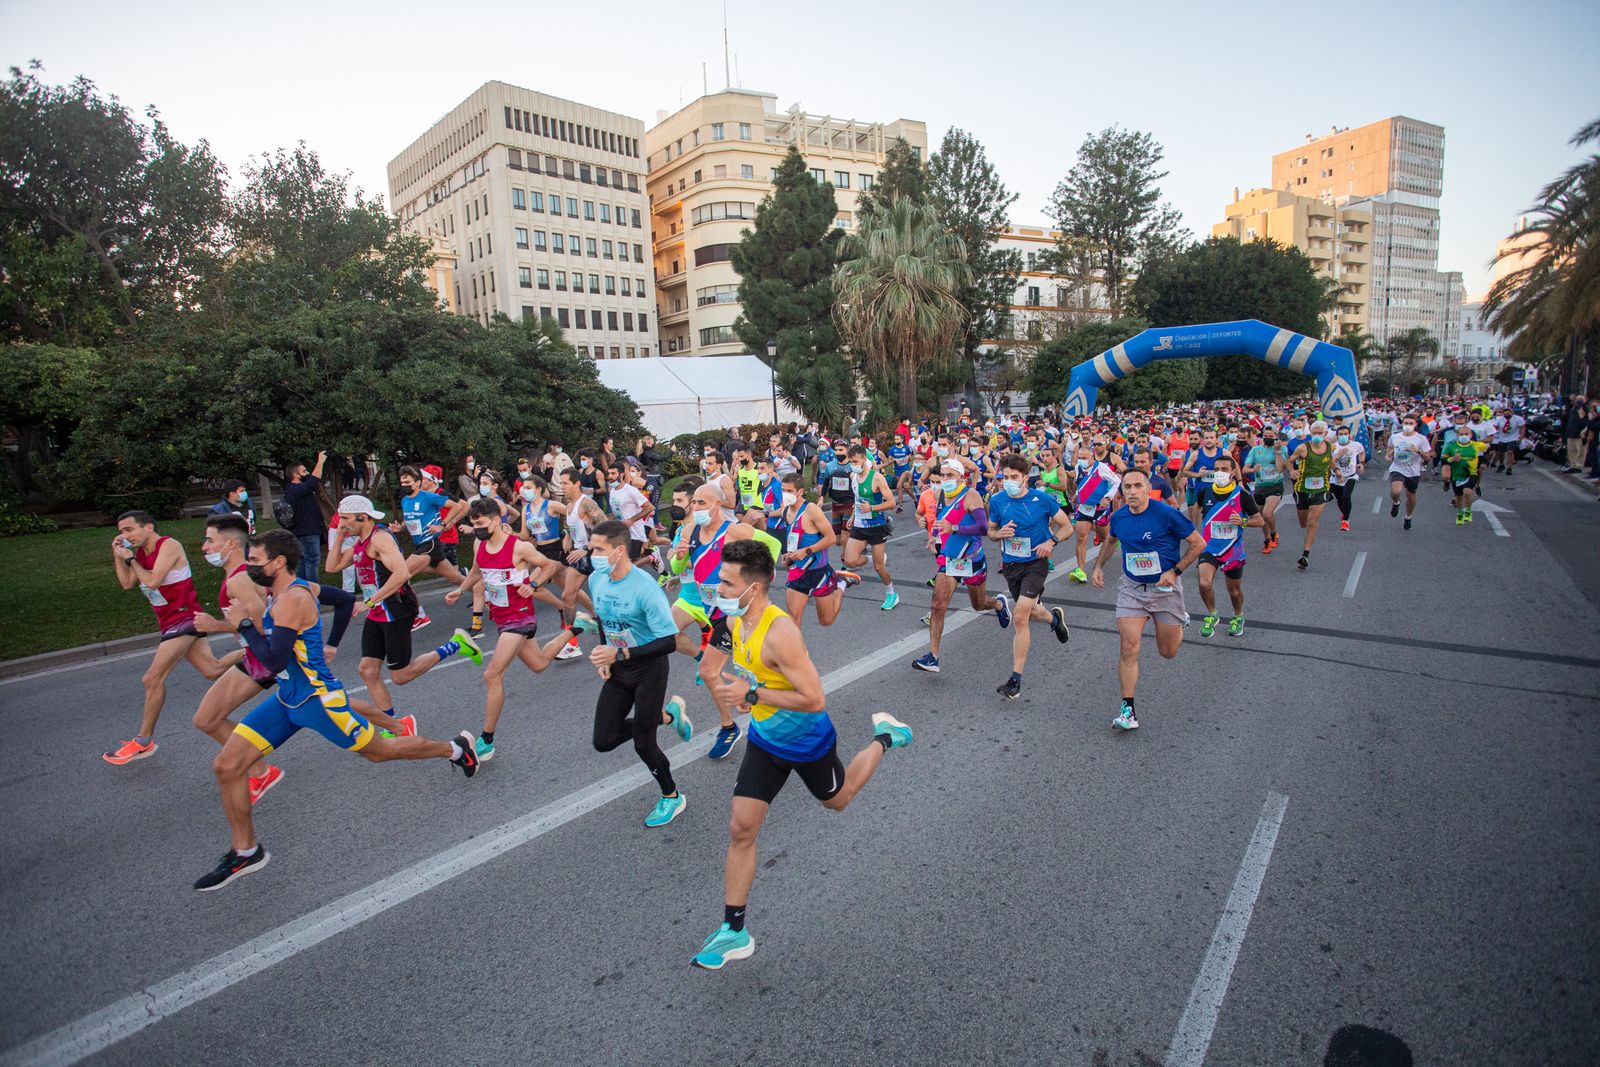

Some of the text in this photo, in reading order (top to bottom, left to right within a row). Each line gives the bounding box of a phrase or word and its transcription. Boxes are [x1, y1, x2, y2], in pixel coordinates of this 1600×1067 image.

[1135, 559, 1153, 569] 109
[707, 591, 713, 600] 3
[609, 638, 628, 648] 100
